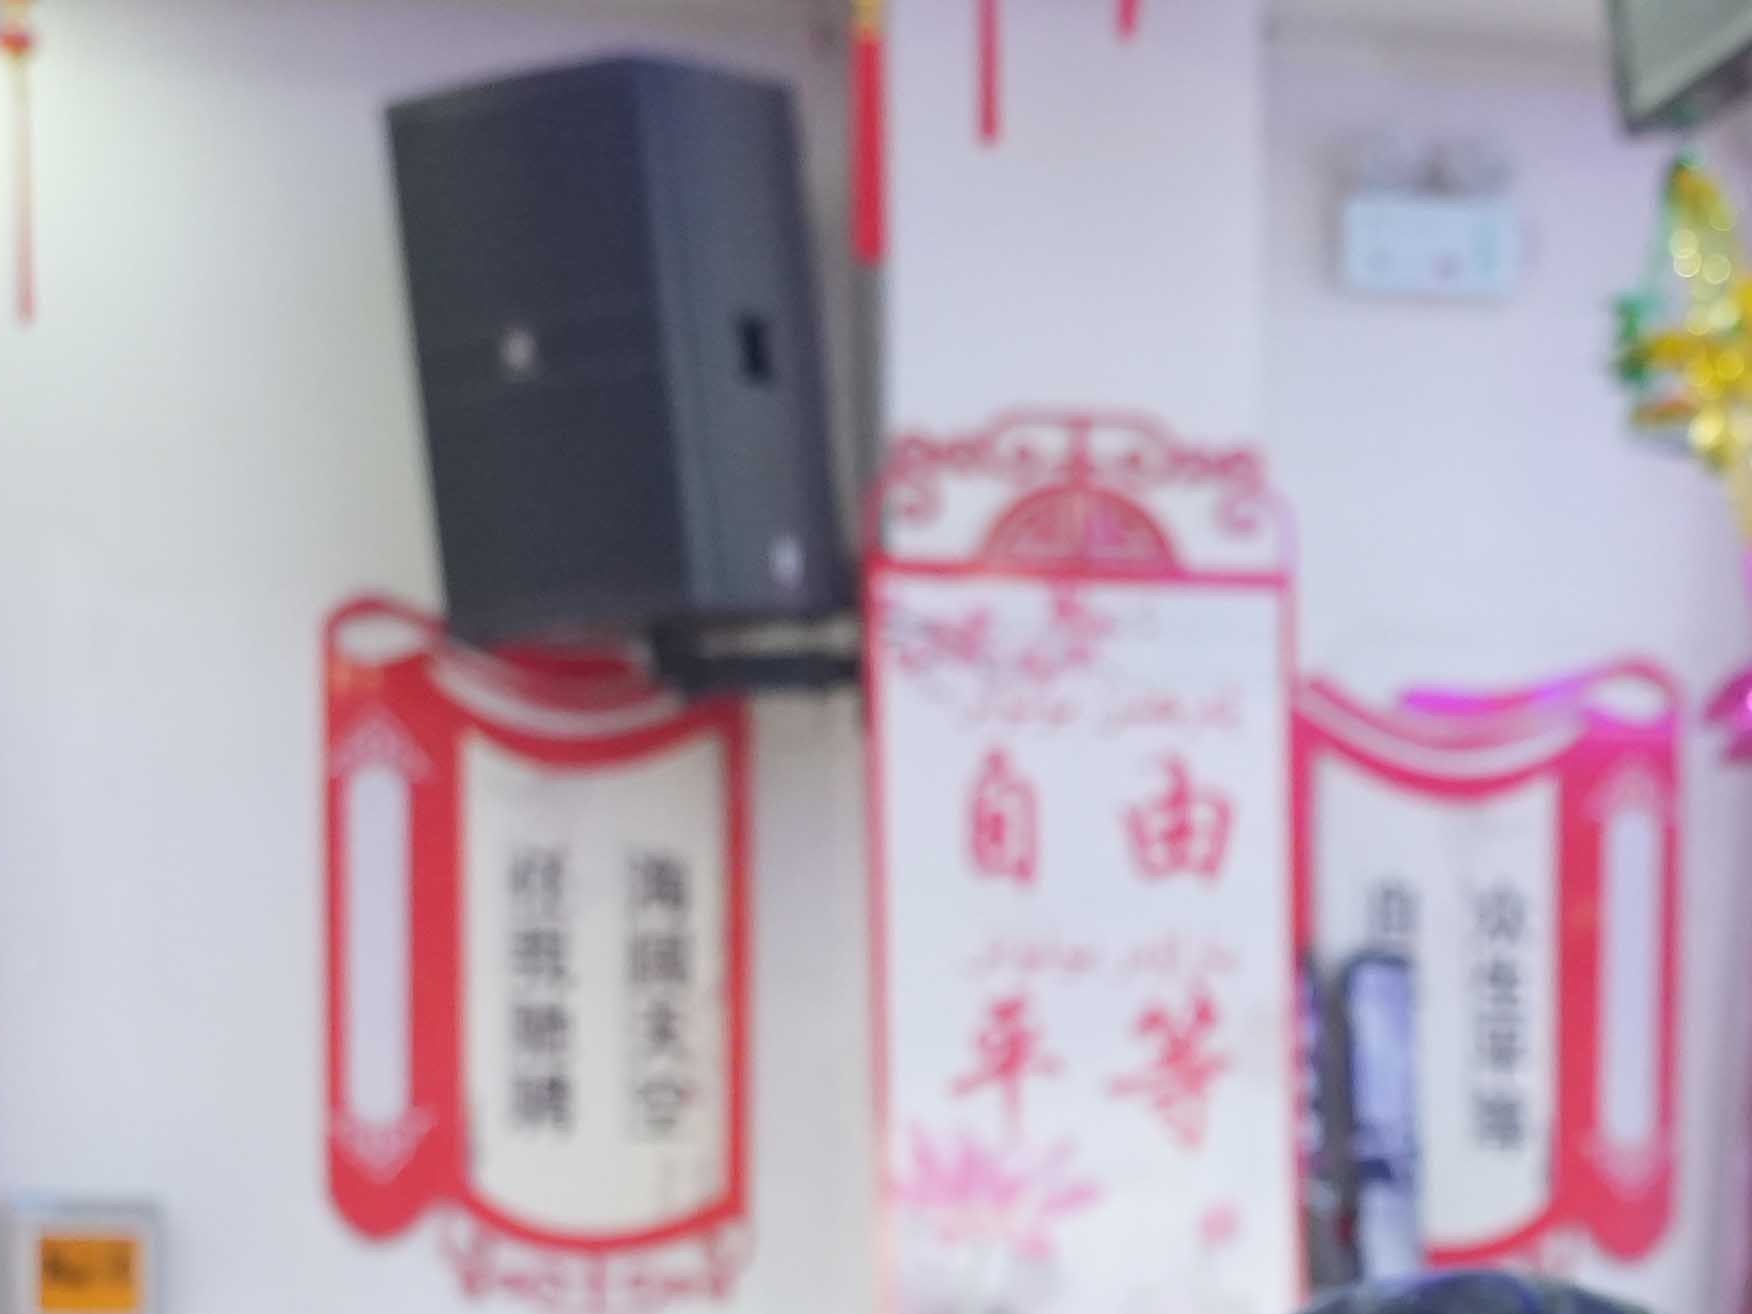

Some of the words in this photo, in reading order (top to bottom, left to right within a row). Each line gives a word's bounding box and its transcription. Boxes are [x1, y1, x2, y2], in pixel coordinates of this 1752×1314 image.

[967, 748, 1234, 886] 自由
[628, 851, 694, 1132] 海阔天空
[951, 992, 1230, 1147] 平等
